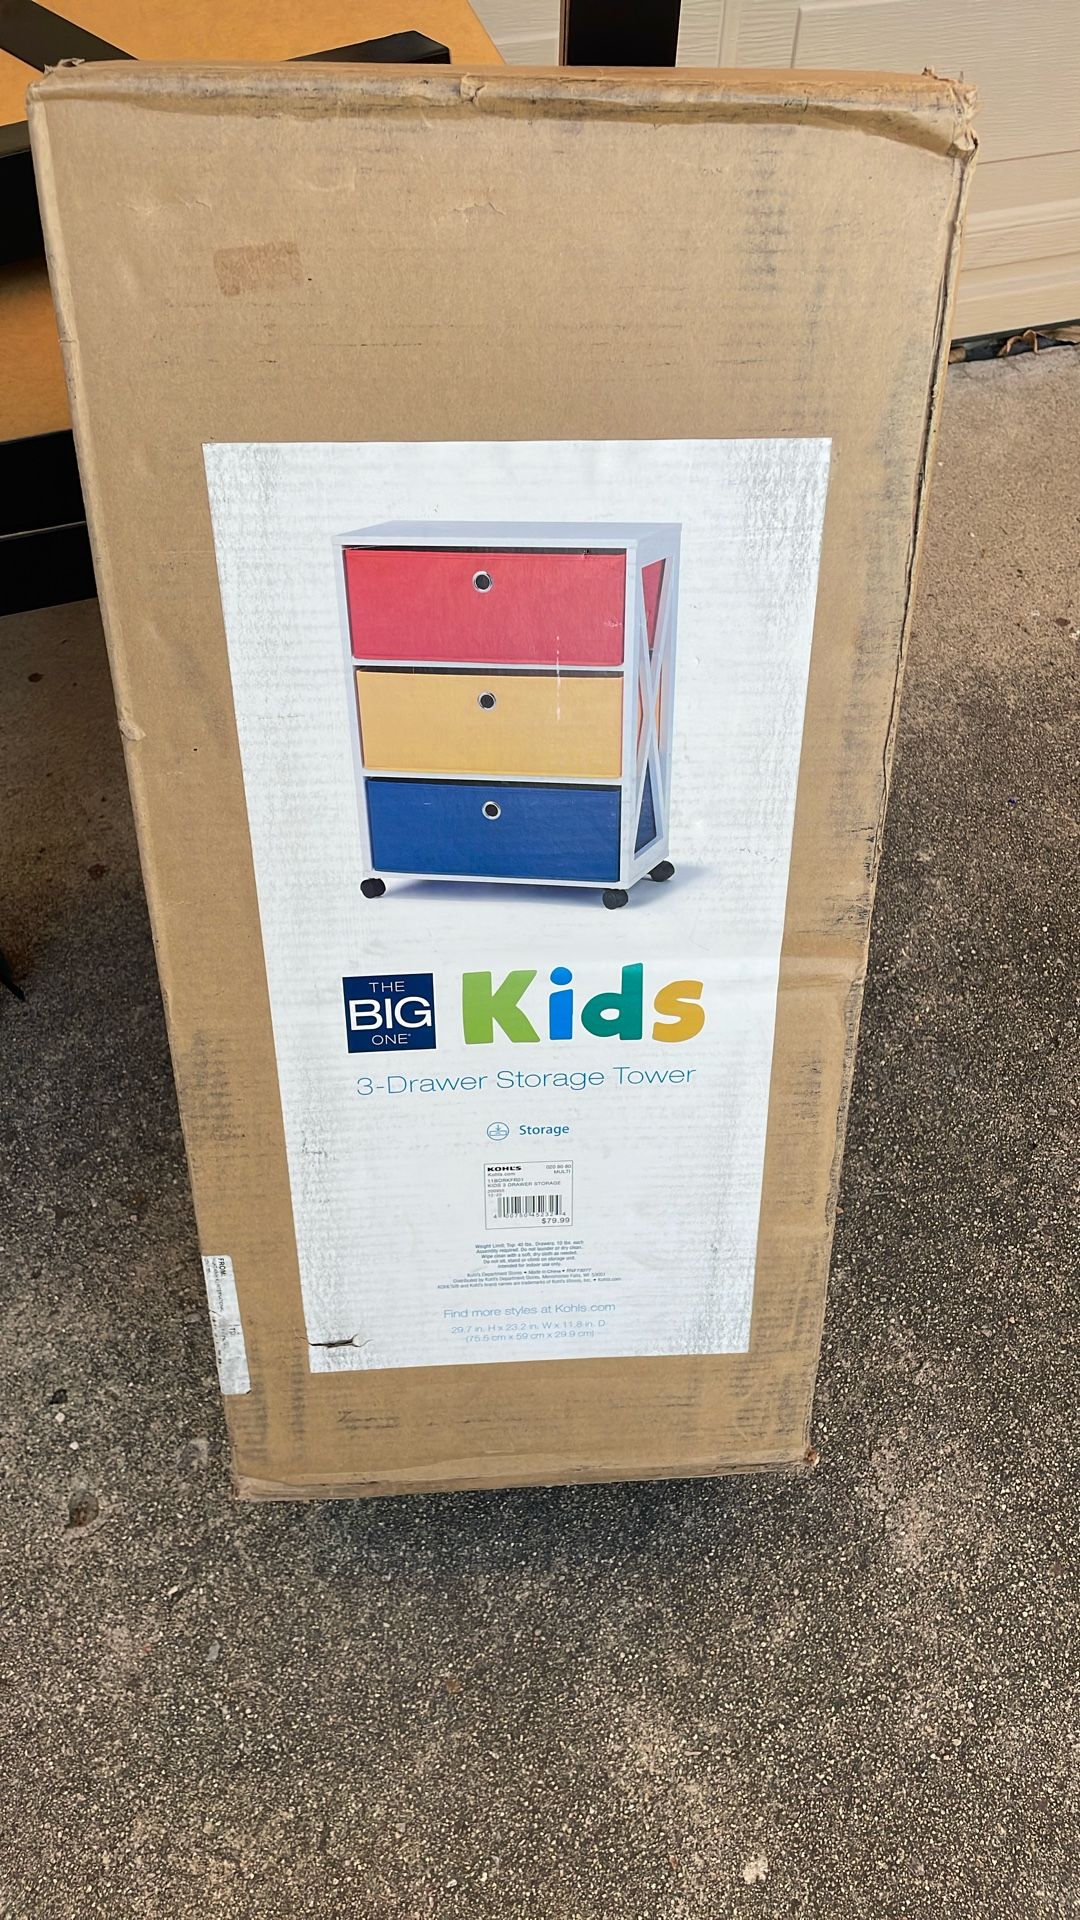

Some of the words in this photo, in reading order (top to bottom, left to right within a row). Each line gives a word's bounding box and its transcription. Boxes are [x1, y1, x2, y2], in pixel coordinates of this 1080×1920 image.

[369, 981, 405, 992] THE
[462, 962, 705, 1044] Kids
[348, 996, 432, 1031] BIG
[356, 1074, 487, 1096] 3-Drawer
[497, 1069, 605, 1091] Storage
[613, 1066, 696, 1085] Tower
[519, 1125, 569, 1136] Storage
[444, 1309, 468, 1318] Find
[505, 1306, 537, 1317] styles
[555, 1304, 616, 1313] Kohls.com
[451, 1325, 471, 1334] 29.7
